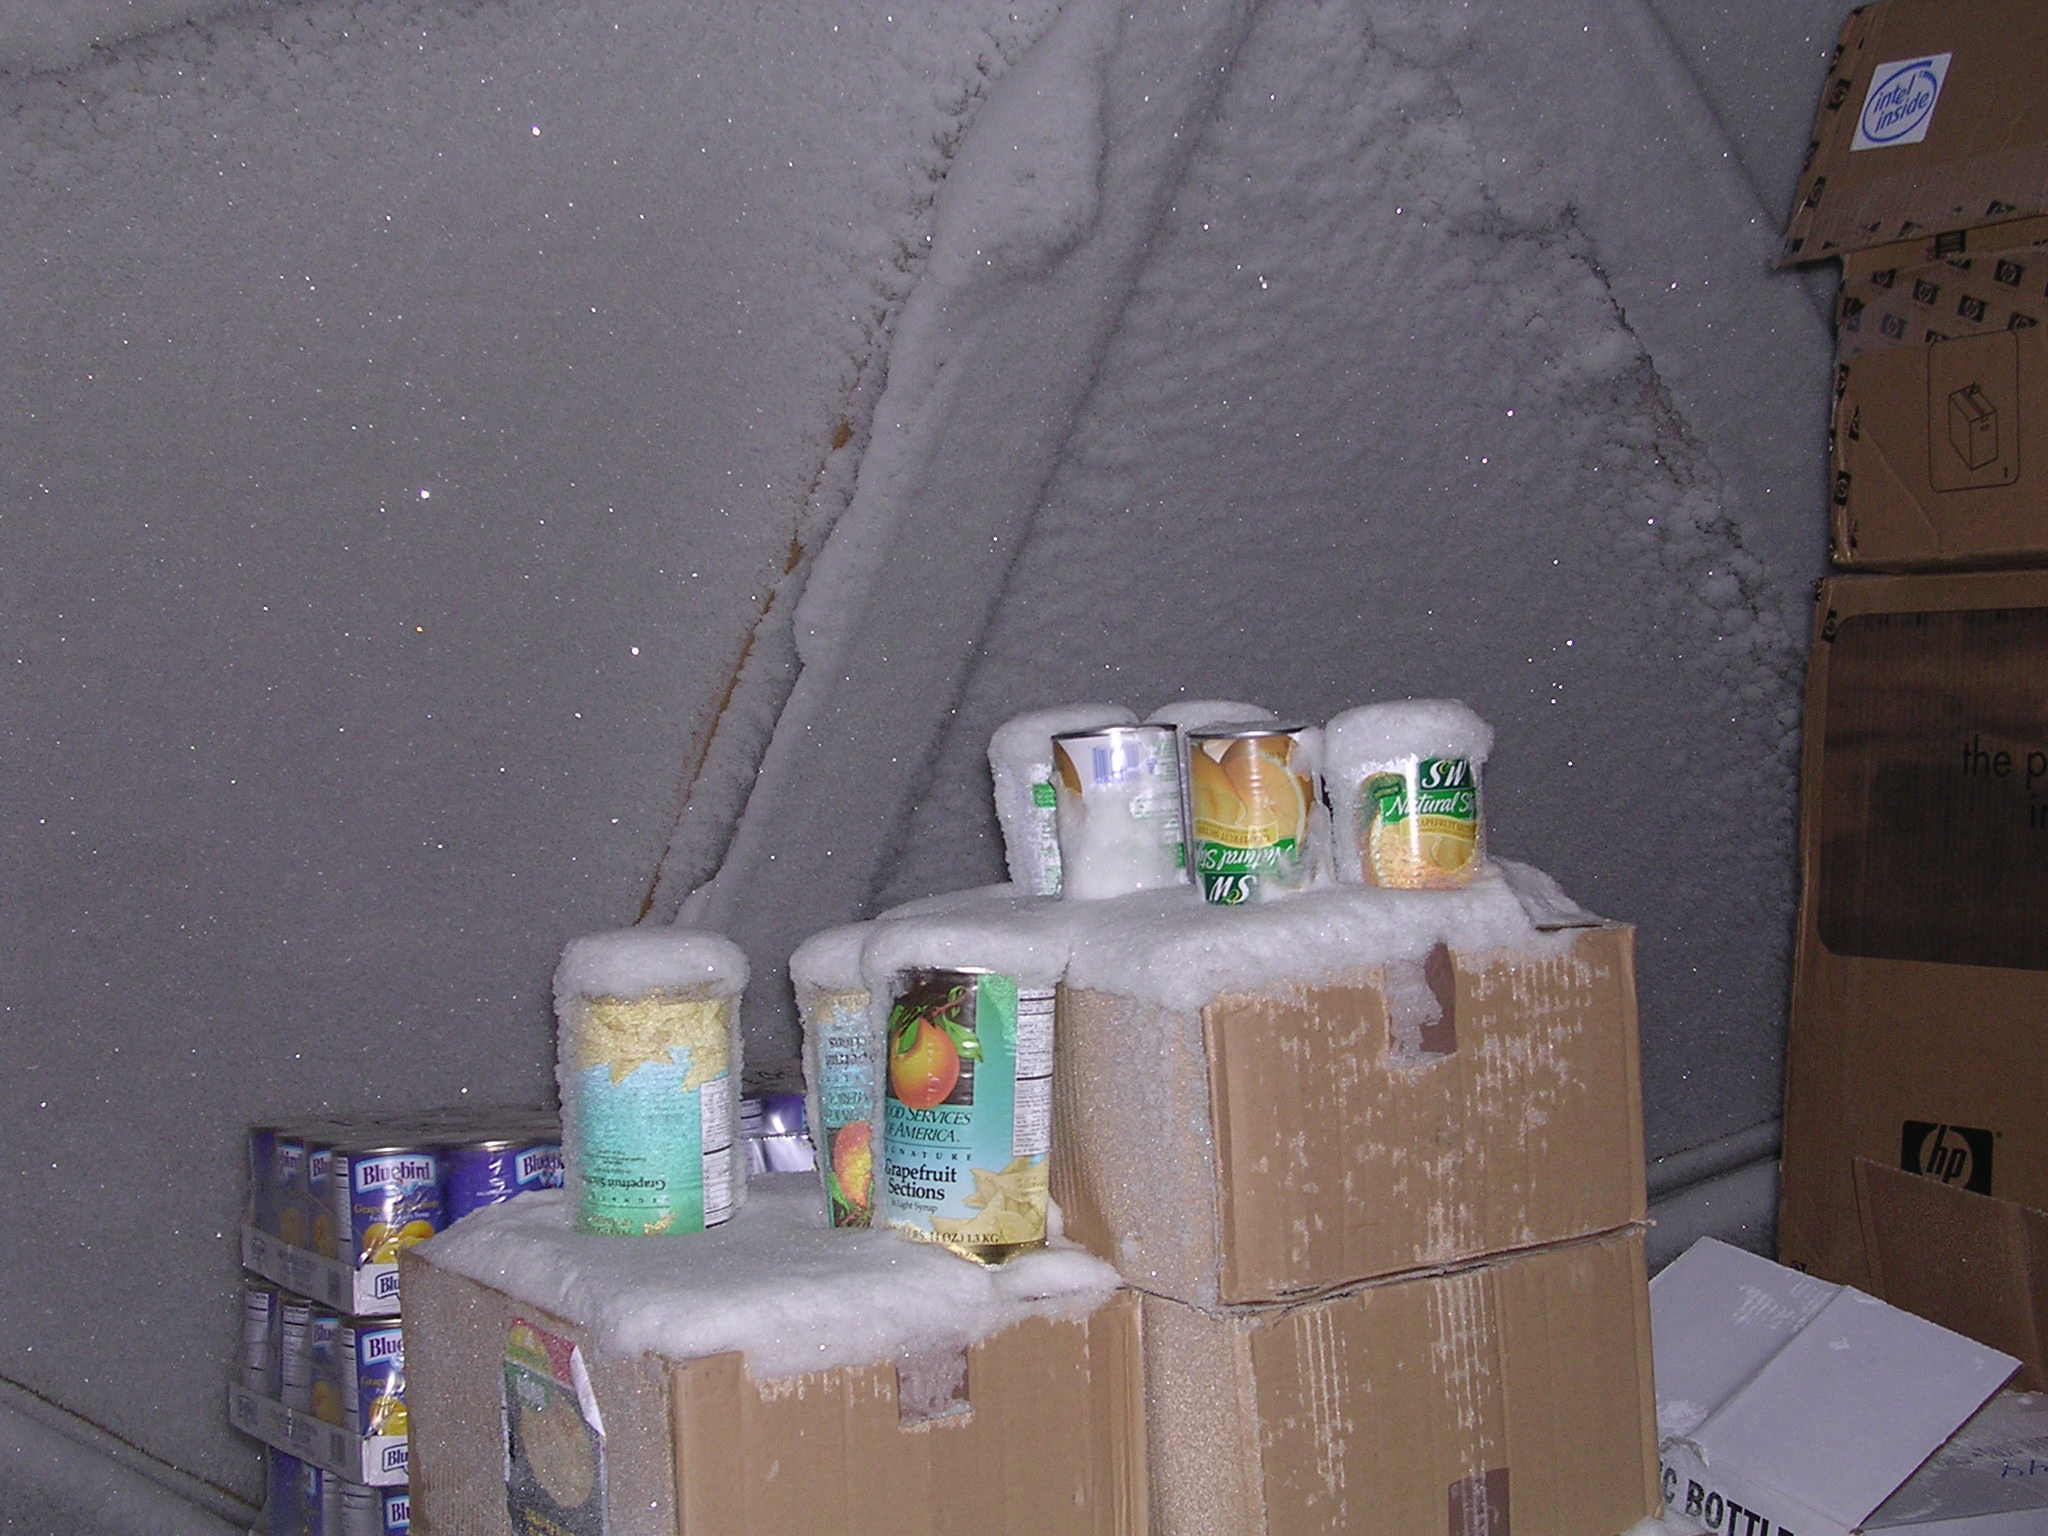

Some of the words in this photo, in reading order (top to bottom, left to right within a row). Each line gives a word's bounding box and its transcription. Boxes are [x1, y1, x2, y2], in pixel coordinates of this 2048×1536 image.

[1873, 75, 1916, 113] intel
[1874, 90, 1930, 133] inside
[1962, 733, 2012, 778] the
[906, 1106, 973, 1126] SERVICES
[363, 1161, 431, 1186] Bluebird
[884, 1157, 958, 1183] Grapefruit
[887, 1177, 946, 1201] Sections
